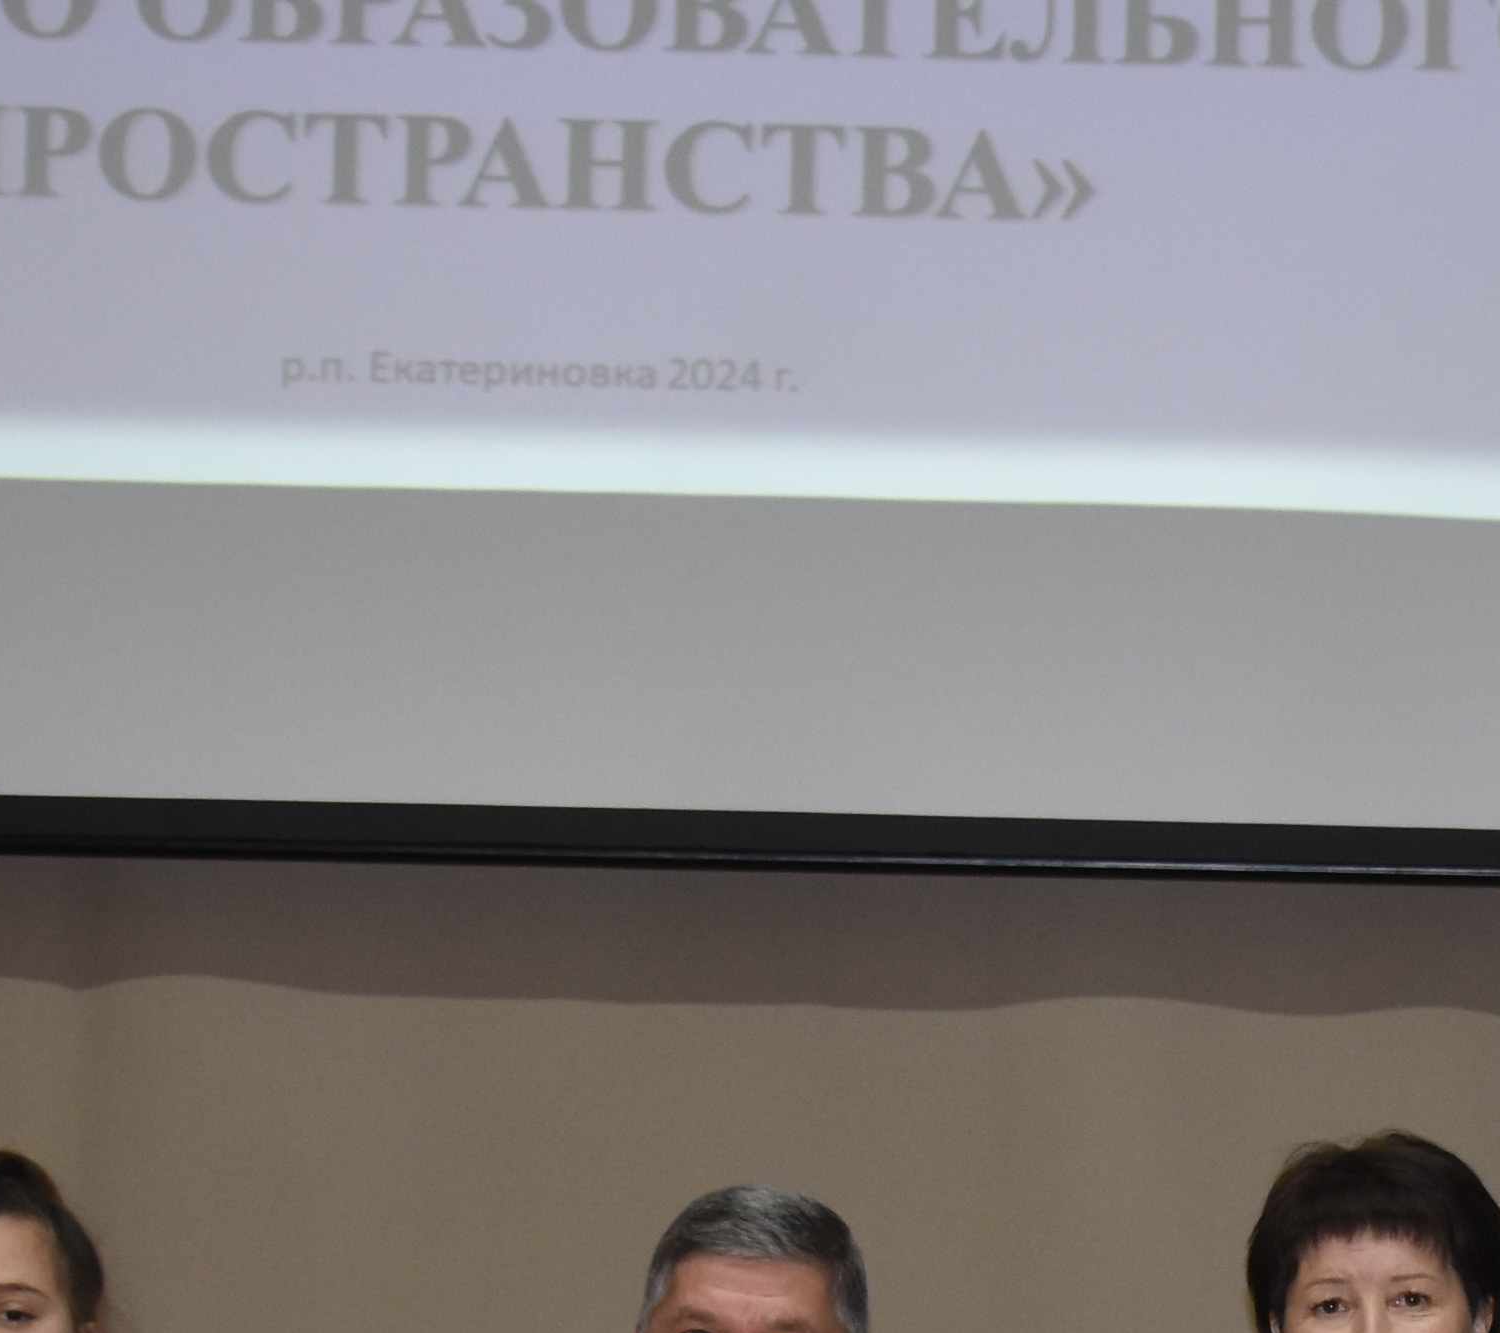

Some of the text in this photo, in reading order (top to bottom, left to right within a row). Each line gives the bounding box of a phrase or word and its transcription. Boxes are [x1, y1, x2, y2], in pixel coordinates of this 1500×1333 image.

[280, 350, 799, 393] р.п. Екатериновка 2024 г.
